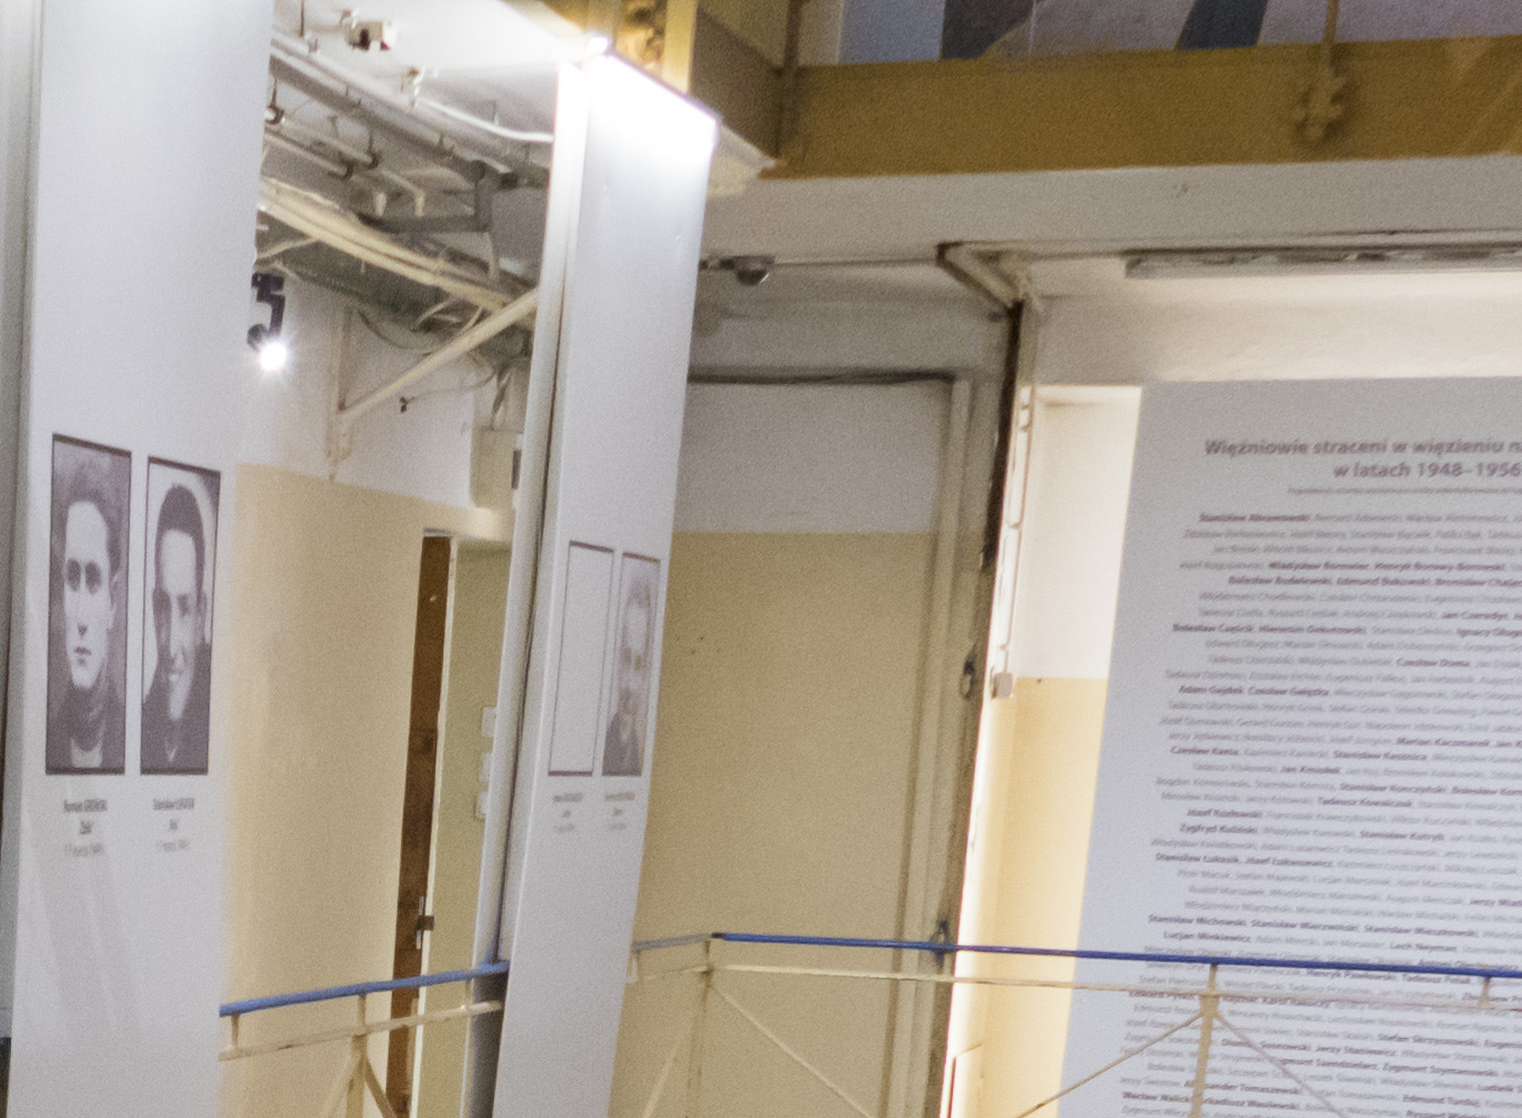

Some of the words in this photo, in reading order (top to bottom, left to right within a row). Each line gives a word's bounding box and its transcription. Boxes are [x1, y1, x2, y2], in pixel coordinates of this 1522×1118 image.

[1205, 437, 1308, 459] Więźniowie
[1313, 439, 1388, 455] straceni
[1392, 441, 1408, 454] w
[1412, 439, 1505, 458] więzieniu
[1334, 464, 1350, 478] w
[1353, 460, 1411, 478] latach
